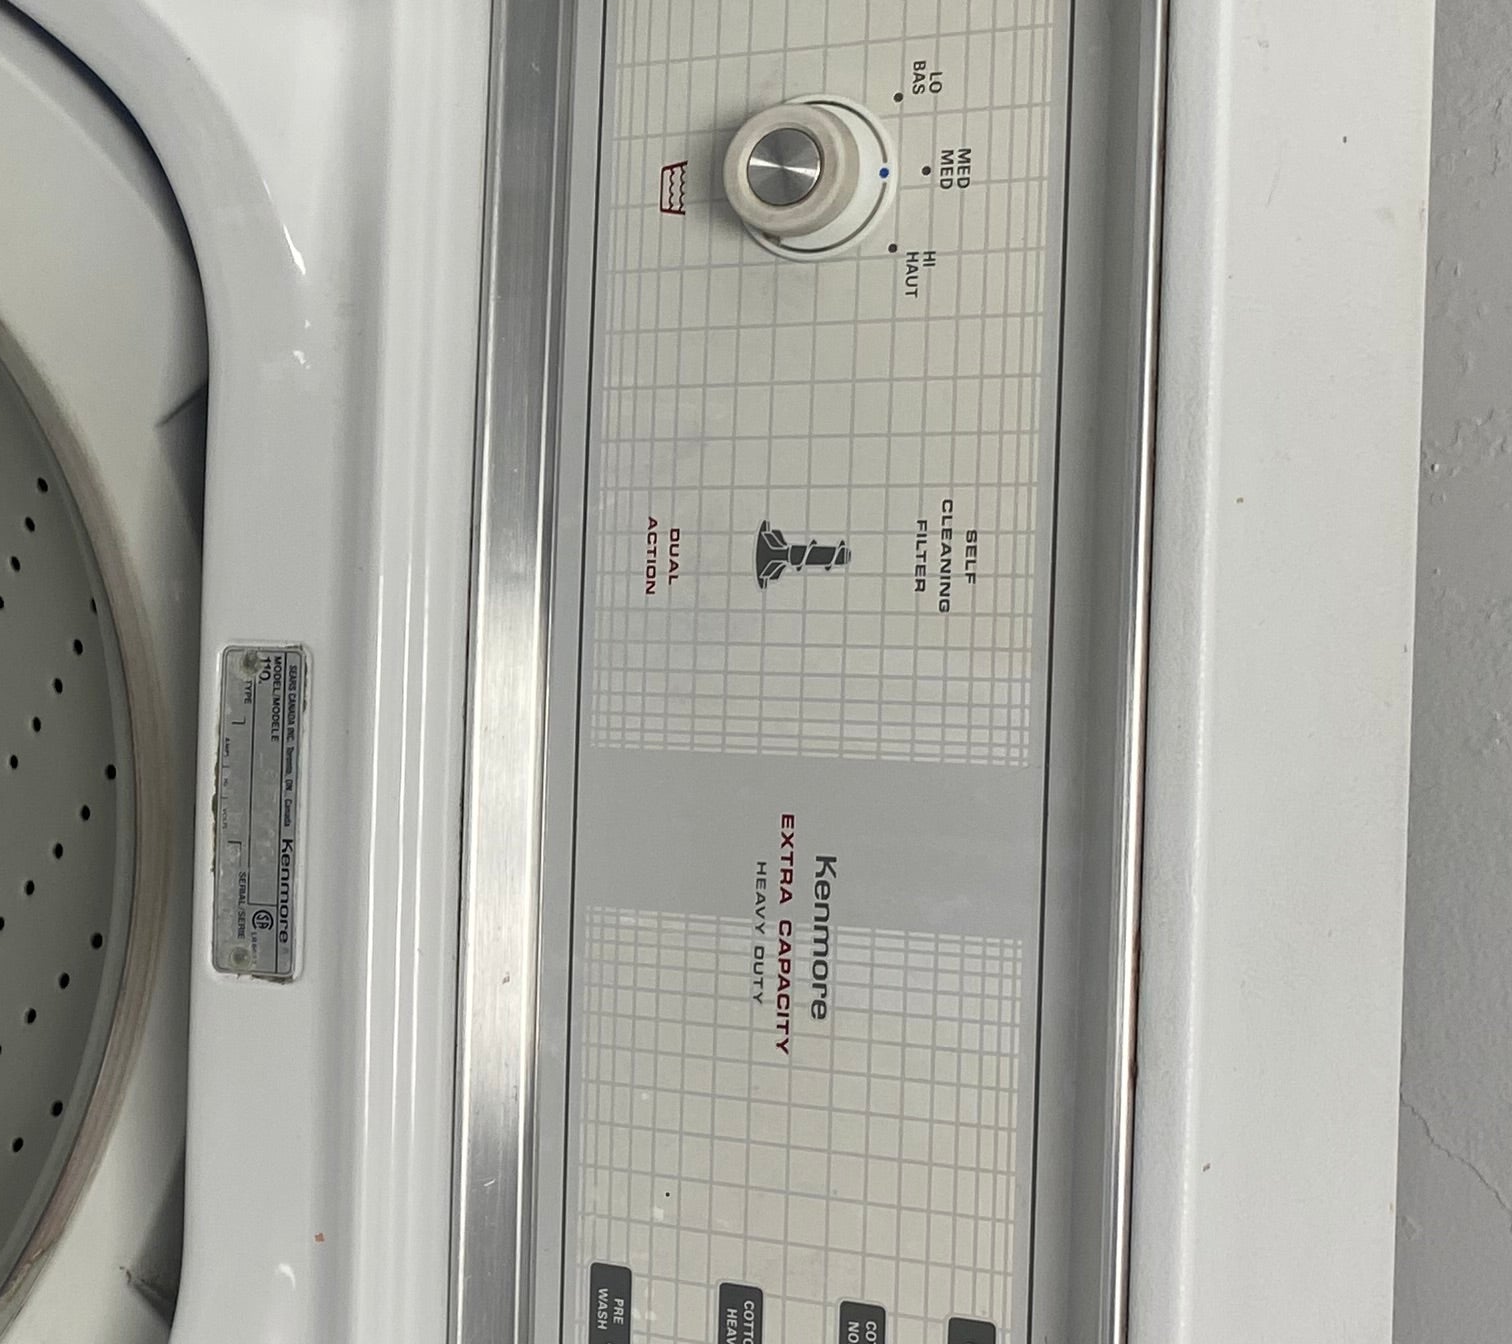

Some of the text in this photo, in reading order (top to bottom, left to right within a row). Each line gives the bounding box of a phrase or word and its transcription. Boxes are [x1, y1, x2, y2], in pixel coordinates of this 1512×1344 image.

[911, 60, 926, 95] BAS
[928, 71, 943, 94] LO
[939, 149, 954, 190] MED
[956, 148, 971, 188] MED
[904, 251, 920, 298] HAUT
[921, 250, 936, 268] HI
[645, 516, 659, 595] ACTION
[668, 528, 681, 585] DUAL
[914, 519, 928, 593] FILTER
[938, 499, 954, 613] CLEANING
[964, 529, 978, 584] SELF
[244, 680, 252, 704] TYPE
[271, 656, 282, 742] MODEL/MODELE
[288, 665, 297, 691] SEARS
[287, 693, 296, 726] CANADA
[279, 839, 293, 944] Kenmore
[752, 861, 768, 1005] HEAVY DUTY
[775, 813, 795, 1055] EXTRA CAPACITY
[810, 855, 838, 1021] Kenmore
[597, 1287, 609, 1330] WASH
[612, 1298, 624, 1324] PRE
